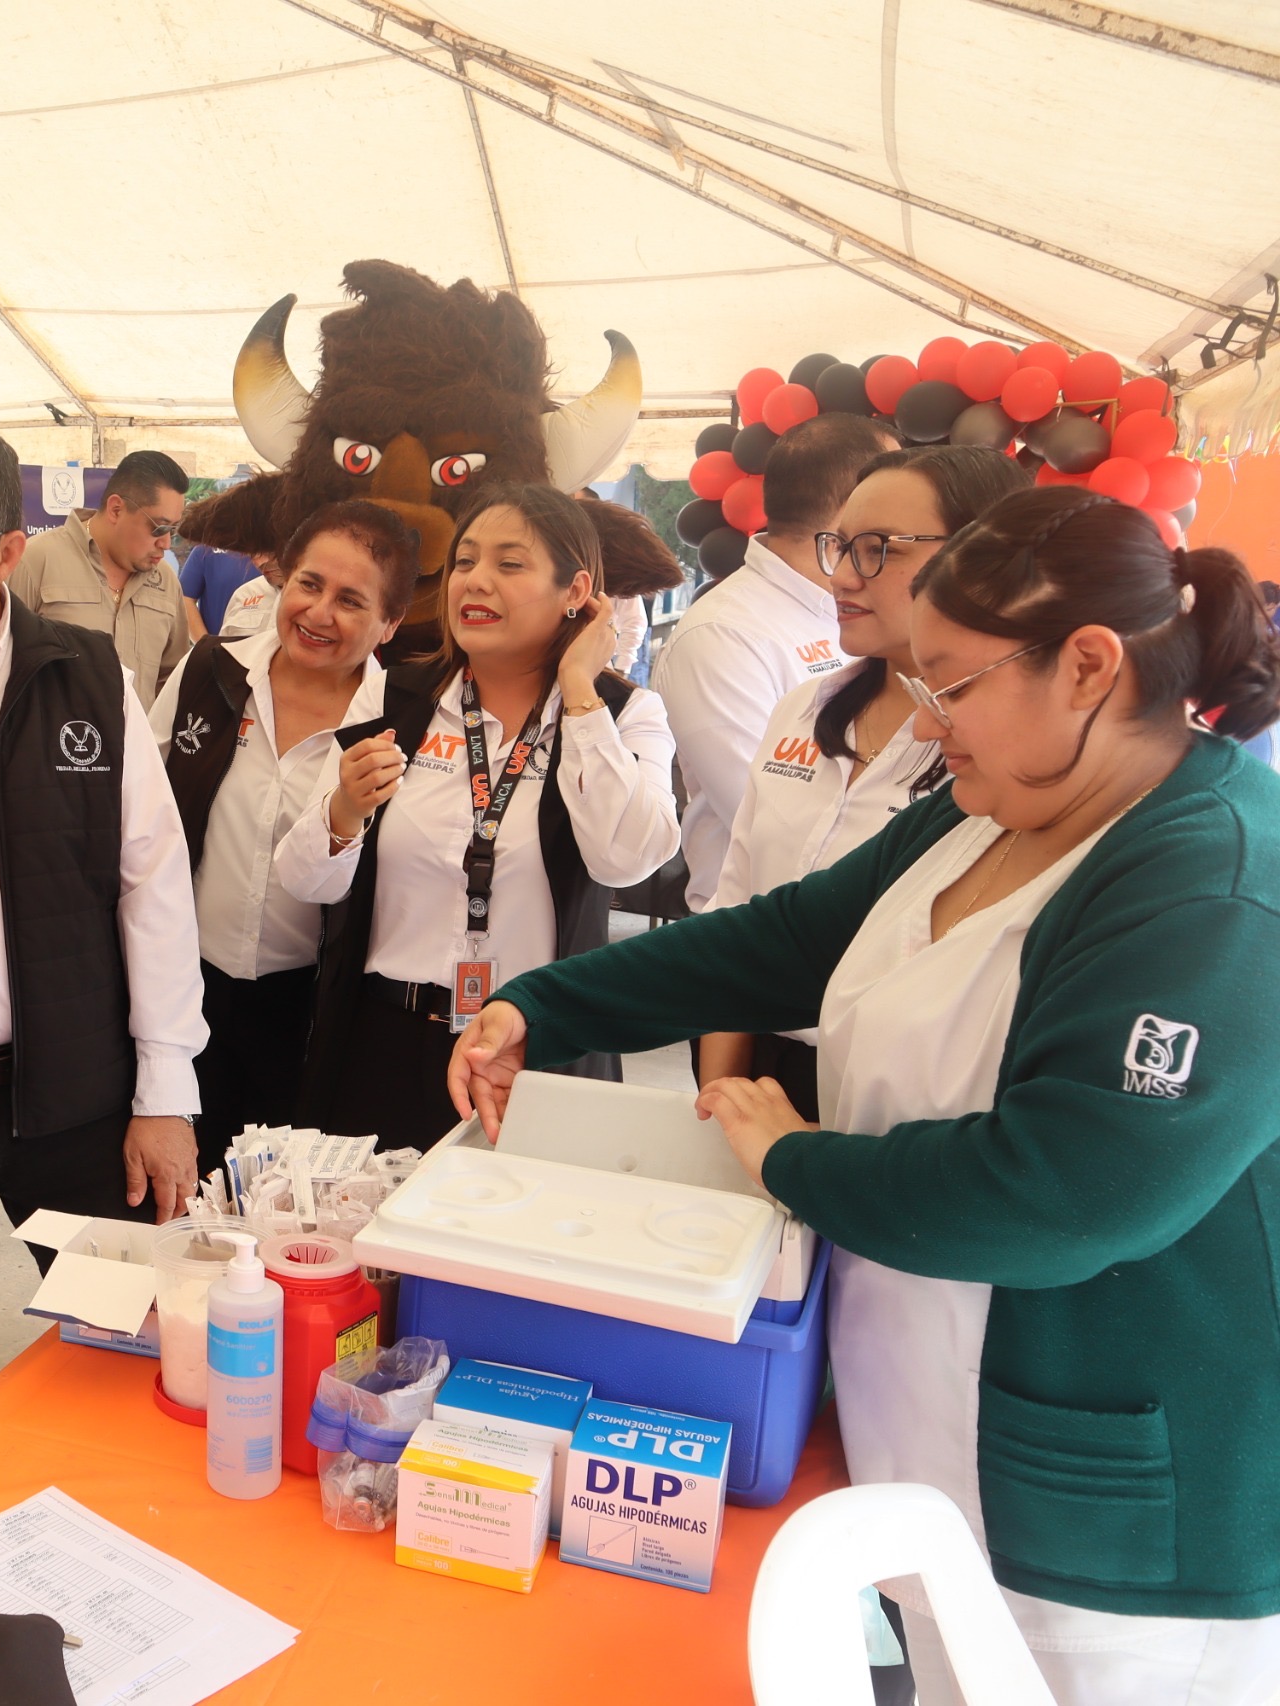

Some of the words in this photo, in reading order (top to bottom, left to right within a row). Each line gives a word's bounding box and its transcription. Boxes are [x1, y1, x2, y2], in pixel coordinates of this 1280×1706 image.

[243, 595, 264, 607] UAT
[796, 639, 835, 664] UAT
[470, 735, 484, 765] LNCA
[506, 741, 532, 775] UAT
[774, 737, 820, 767] UAT
[761, 765, 813, 782] TAMAULIPAS
[472, 773, 491, 809] UAT
[491, 782, 513, 813] LNCA
[1123, 1070, 1184, 1099] IMSS
[226, 1393, 272, 1405] 6000270
[496, 1379, 580, 1402] Hipodérmicas
[499, 1388, 540, 1401] Agujas
[587, 1412, 672, 1434] HIPODÉRMICAS
[431, 1441, 464, 1453] Calibre
[675, 1429, 721, 1444] AGUJAS
[442, 1459, 457, 1467] 100
[417, 1500, 447, 1514] Agujas
[449, 1507, 511, 1528] Hipodérmicas
[571, 1494, 615, 1516] AGUJAS
[619, 1506, 707, 1535] HIPODÉRMICAS
[417, 1532, 450, 1547] Calibre
[434, 1560, 449, 1570] 100
